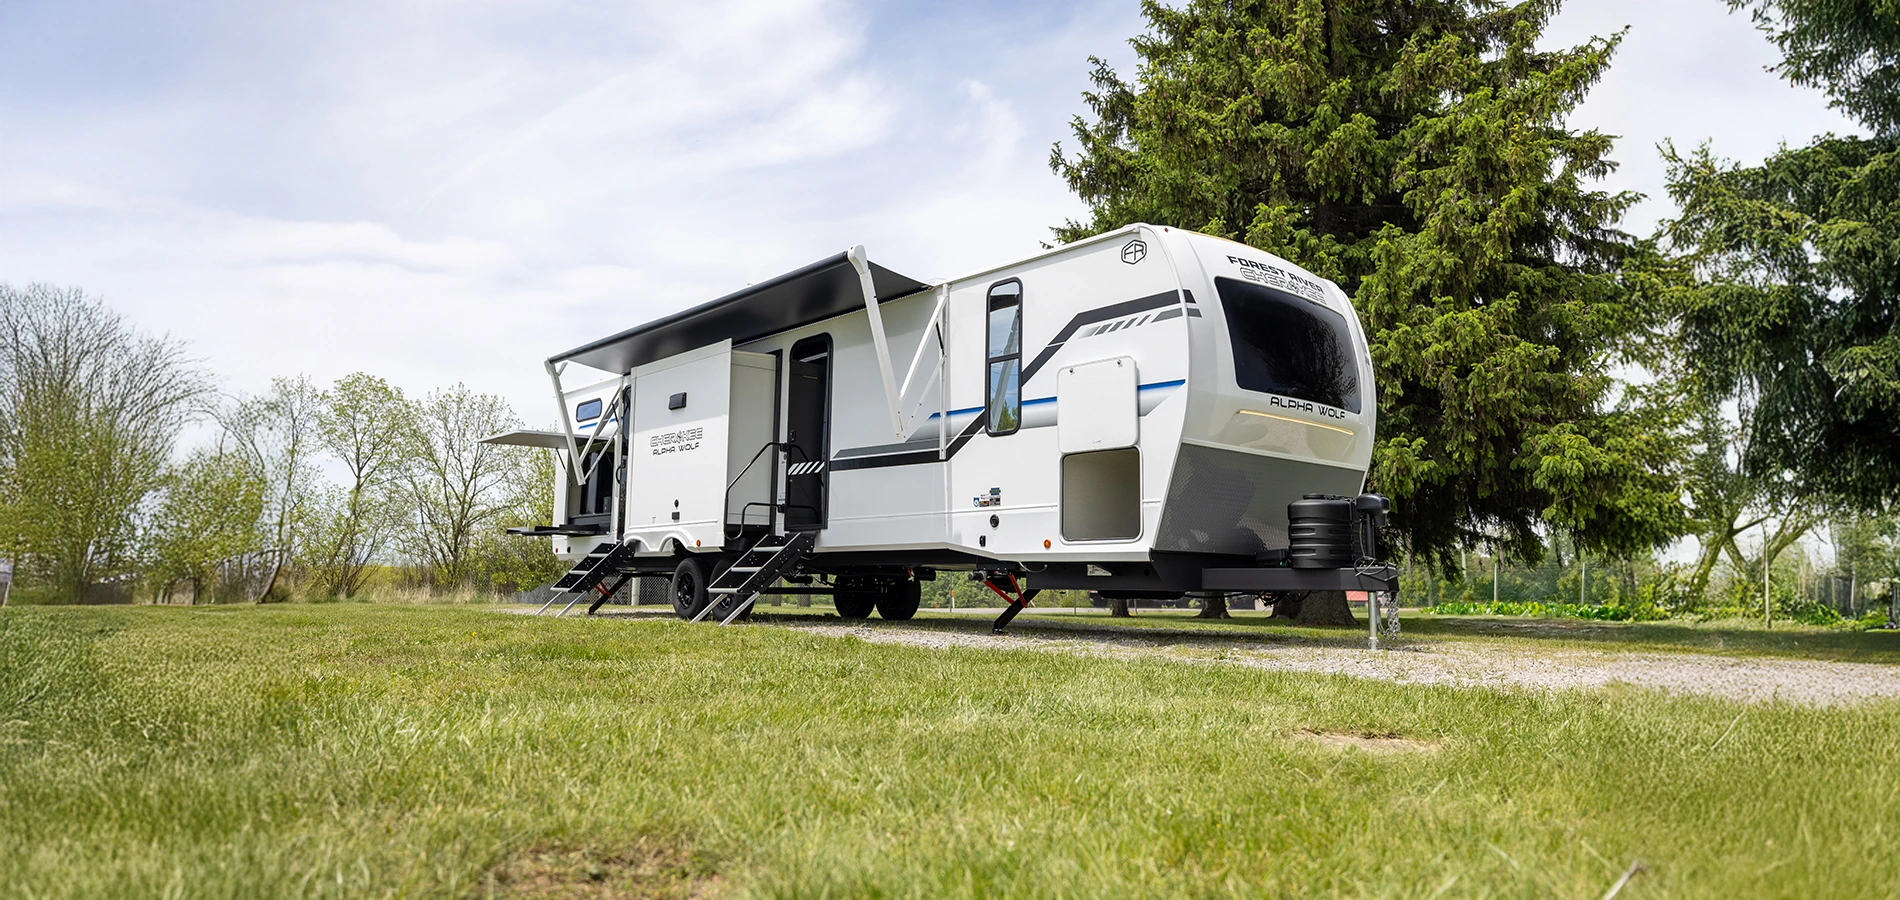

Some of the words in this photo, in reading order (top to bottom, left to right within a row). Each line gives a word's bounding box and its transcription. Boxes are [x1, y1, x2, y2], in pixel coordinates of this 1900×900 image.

[1226, 254, 1285, 277] FOREST
[1287, 271, 1325, 295] RIVER
[1270, 396, 1314, 413] ALPHA
[1318, 405, 1346, 420] WOLF
[652, 446, 676, 456] ALPHA
[678, 441, 700, 452] WOLF
